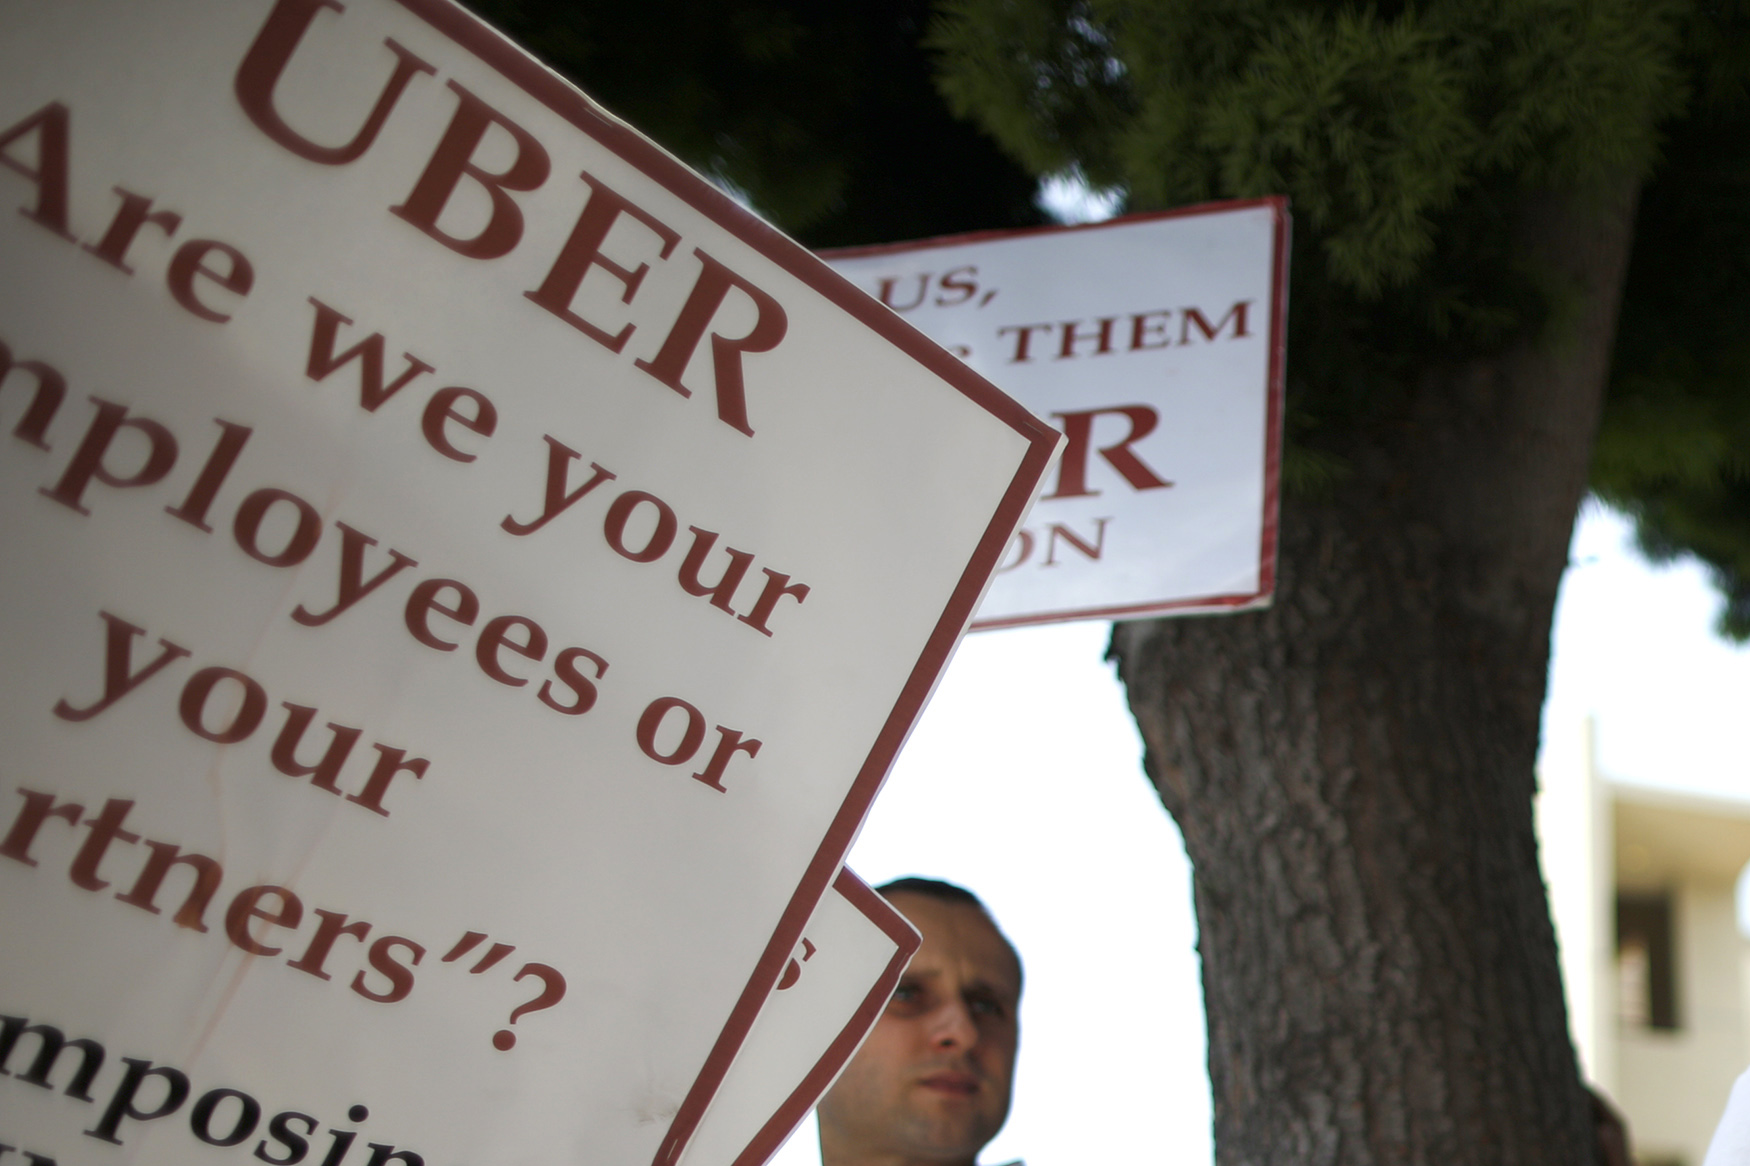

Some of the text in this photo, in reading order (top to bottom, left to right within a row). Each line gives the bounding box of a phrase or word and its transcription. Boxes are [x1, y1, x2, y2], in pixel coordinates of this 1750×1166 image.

[233, 0, 789, 439] UBER
[0, 100, 811, 639] Are we your
[997, 299, 1257, 365] THEM
[52, 610, 431, 818] your
[636, 697, 763, 794] or
